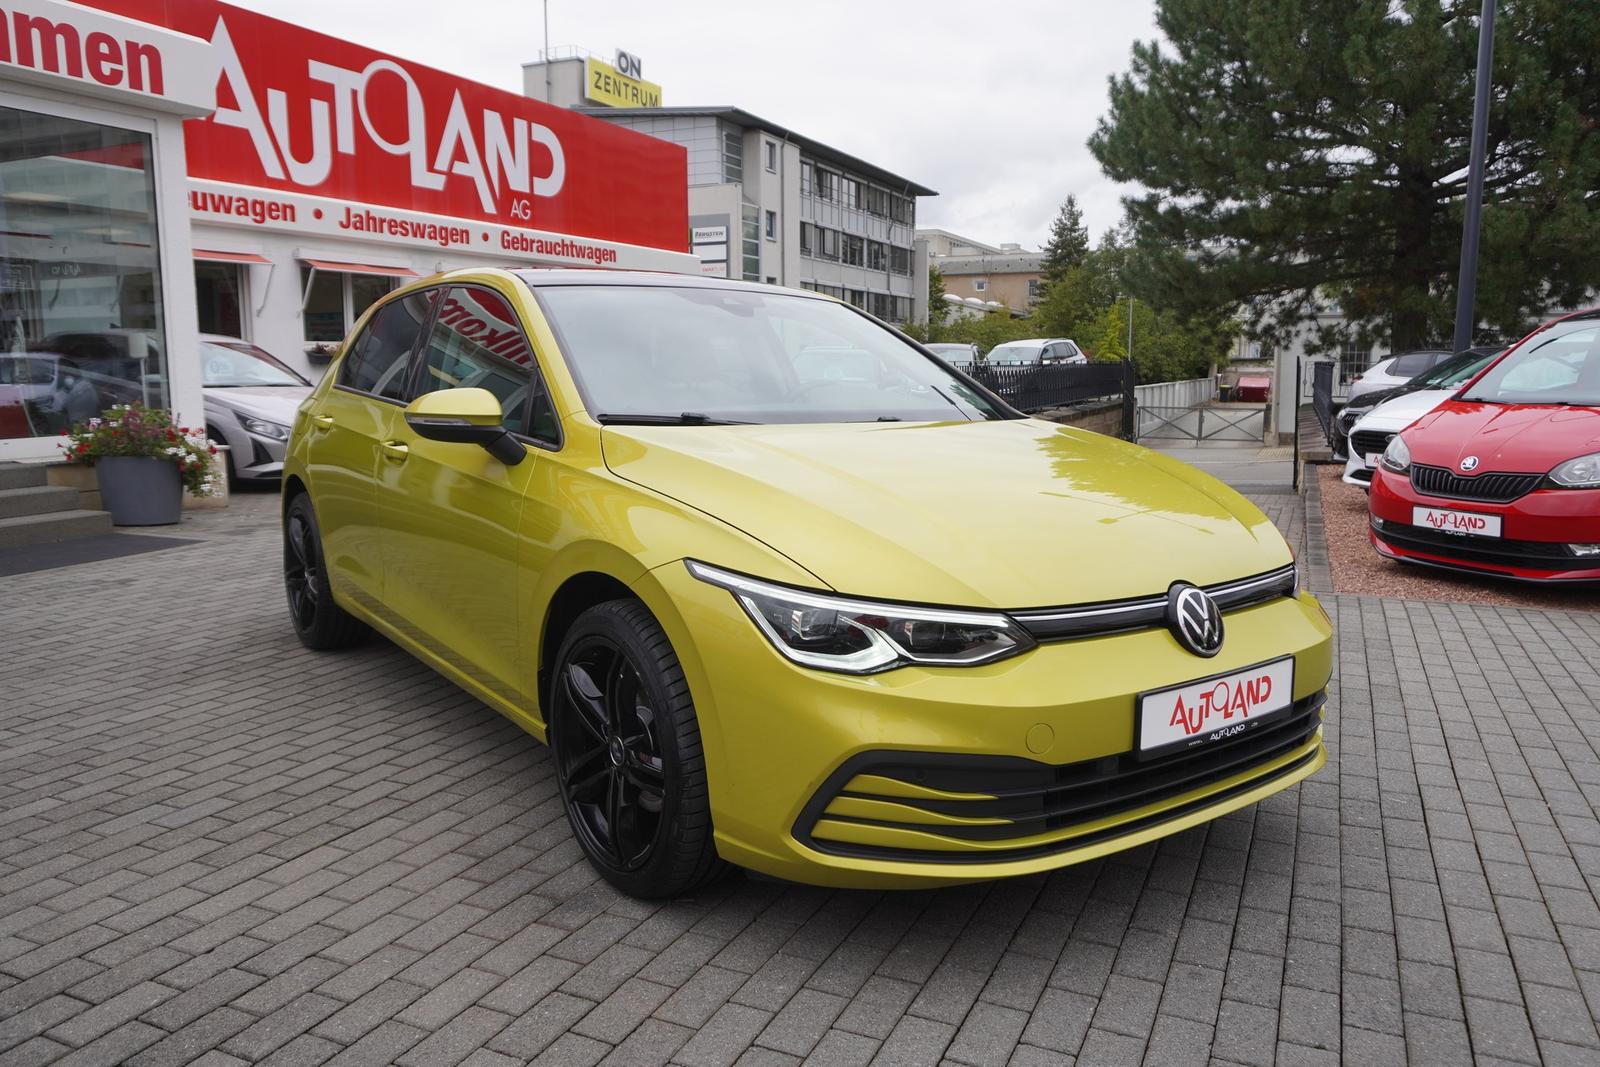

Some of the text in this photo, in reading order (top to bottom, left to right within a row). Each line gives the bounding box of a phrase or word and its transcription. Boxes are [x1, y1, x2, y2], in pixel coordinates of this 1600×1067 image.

[0, 7, 164, 95] men
[618, 51, 641, 79] ON
[594, 70, 658, 107] ZENTRUM
[206, 13, 566, 215] AUTOLAND
[188, 190, 616, 264] uwagen Jahreswagen Gebrauchtwagen
[510, 198, 532, 220] AG
[1426, 511, 1486, 531] AUTOLAND
[1169, 675, 1272, 735] AUTOLAND
[1210, 724, 1246, 741] AUTOLAND
